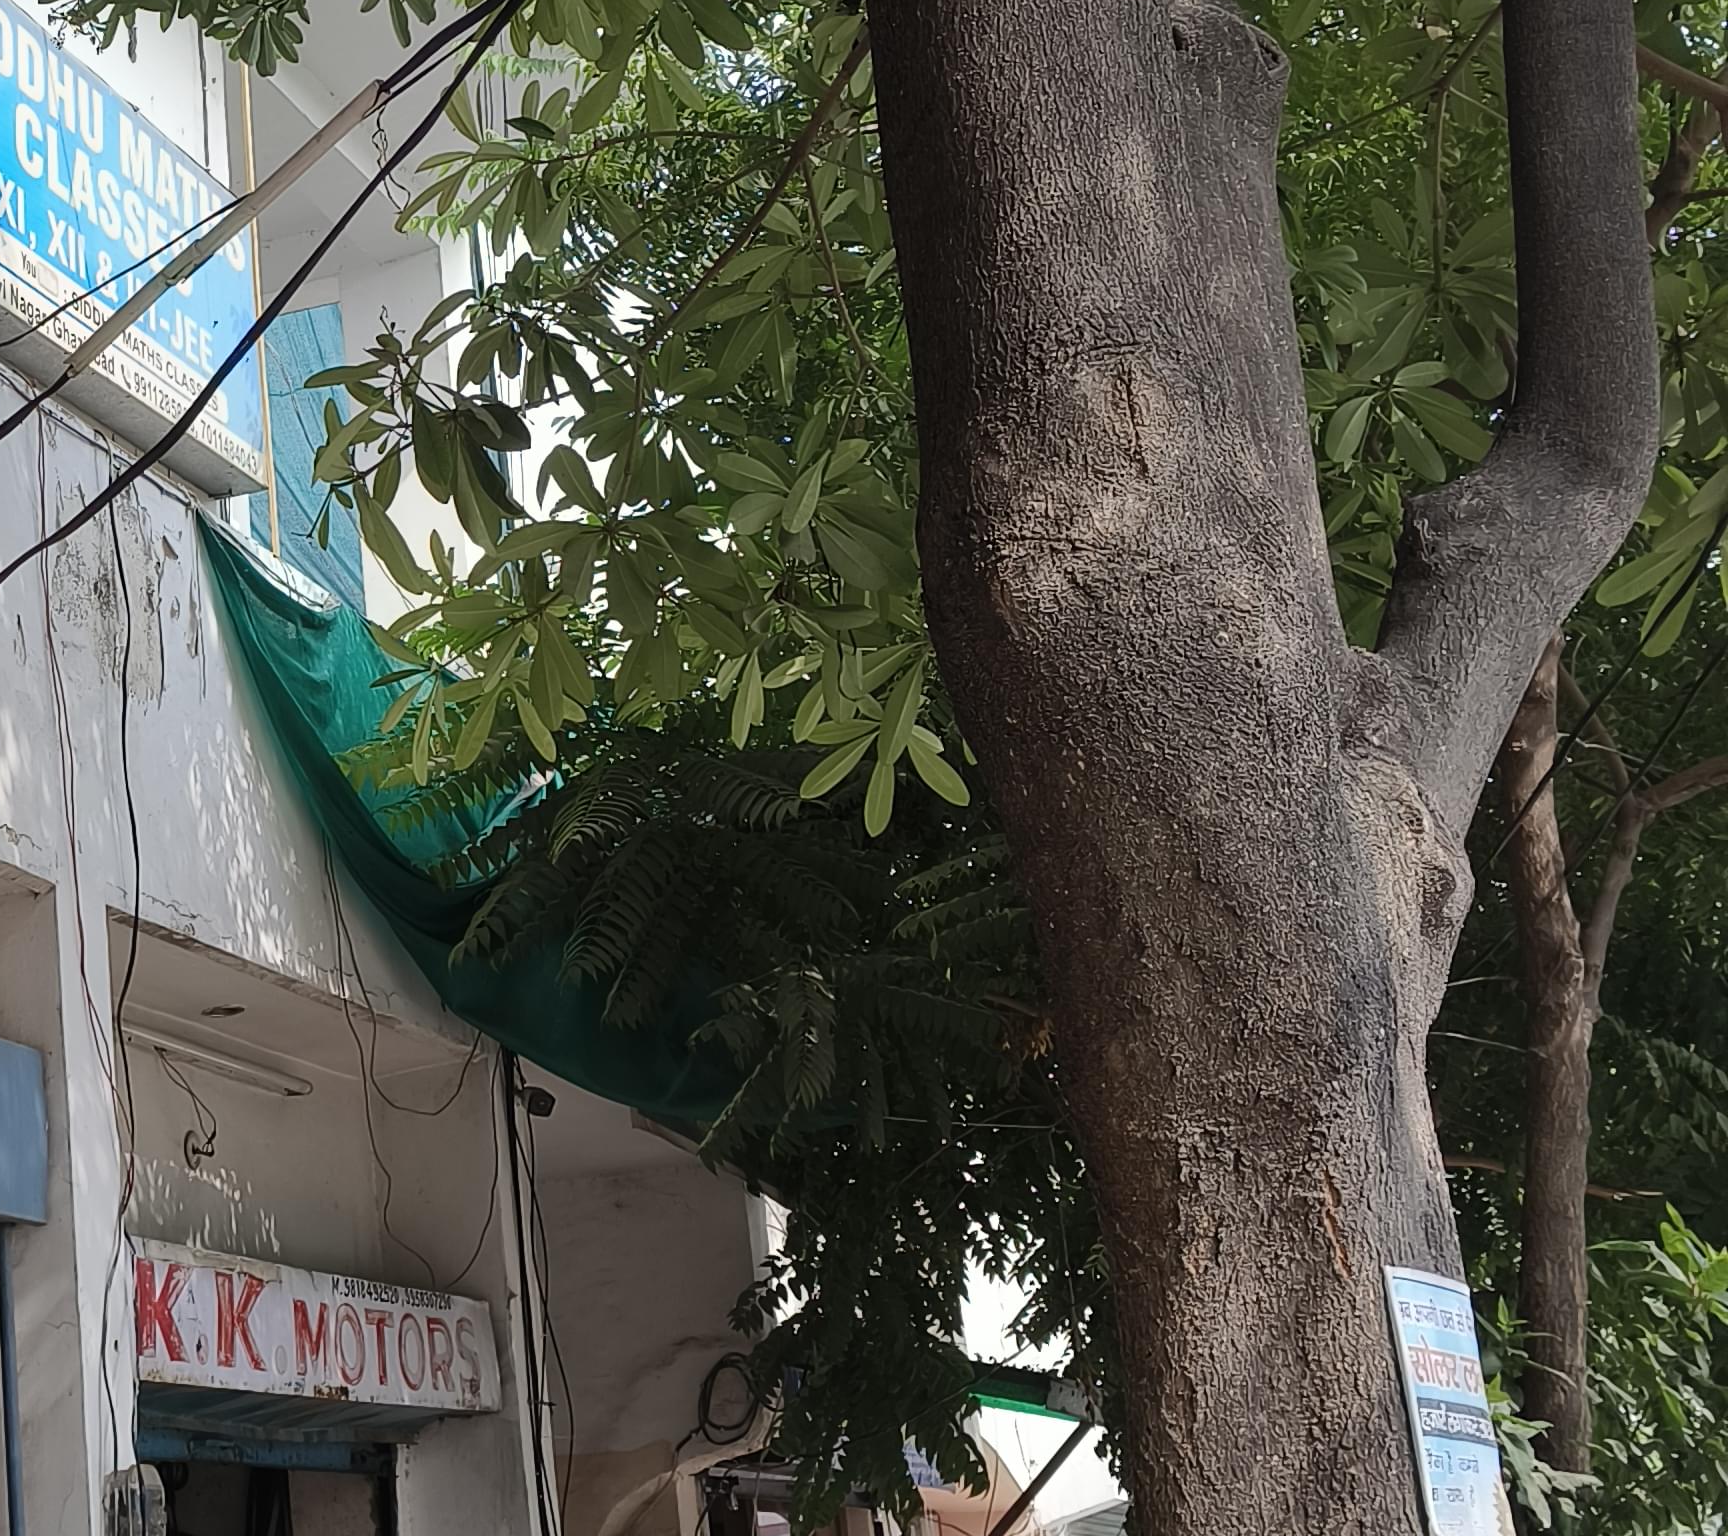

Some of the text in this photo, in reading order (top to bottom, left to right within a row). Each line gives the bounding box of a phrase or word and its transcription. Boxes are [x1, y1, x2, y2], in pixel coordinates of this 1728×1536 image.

[47, 208, 86, 281] XII
[96, 249, 118, 303] &
[72, 291, 110, 326] SIDD
[165, 361, 219, 412] CLASSS
[293, 1297, 482, 1407] MOTORS
